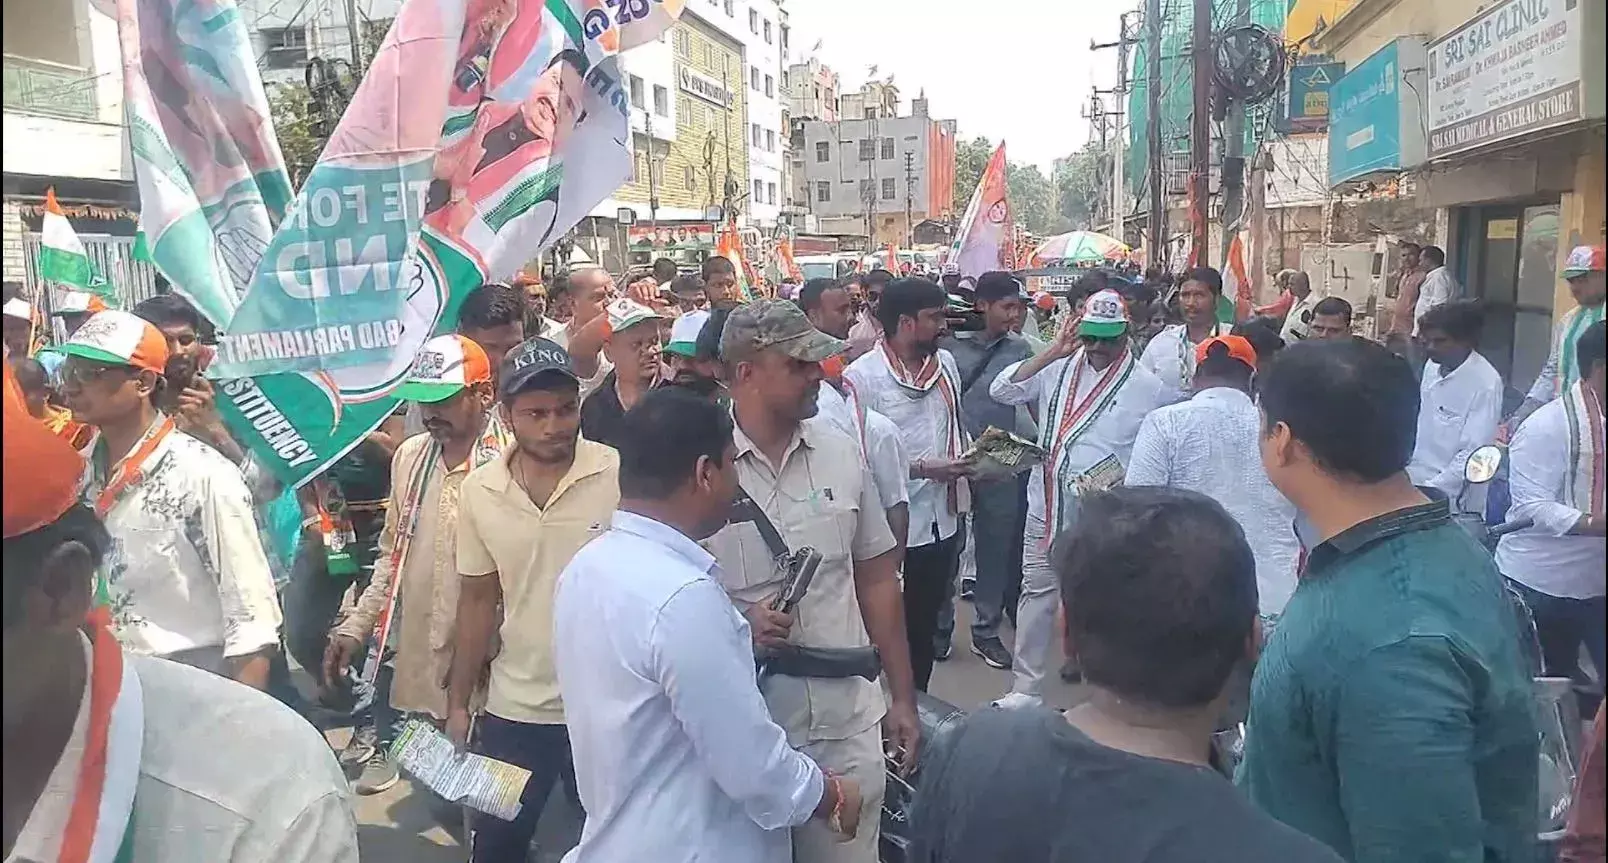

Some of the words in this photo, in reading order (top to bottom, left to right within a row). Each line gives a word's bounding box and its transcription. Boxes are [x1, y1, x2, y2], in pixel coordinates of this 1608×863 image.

[1445, 35, 1464, 69] SRI
[1468, 20, 1492, 57] SAI
[1456, 118, 1488, 145] MEDICAL
[1496, 102, 1538, 132] GENERAL
[1538, 90, 1574, 120] STORE
[1331, 259, 1354, 291] 4
[514, 349, 565, 371] KING
[219, 377, 319, 468] STITUENCY
